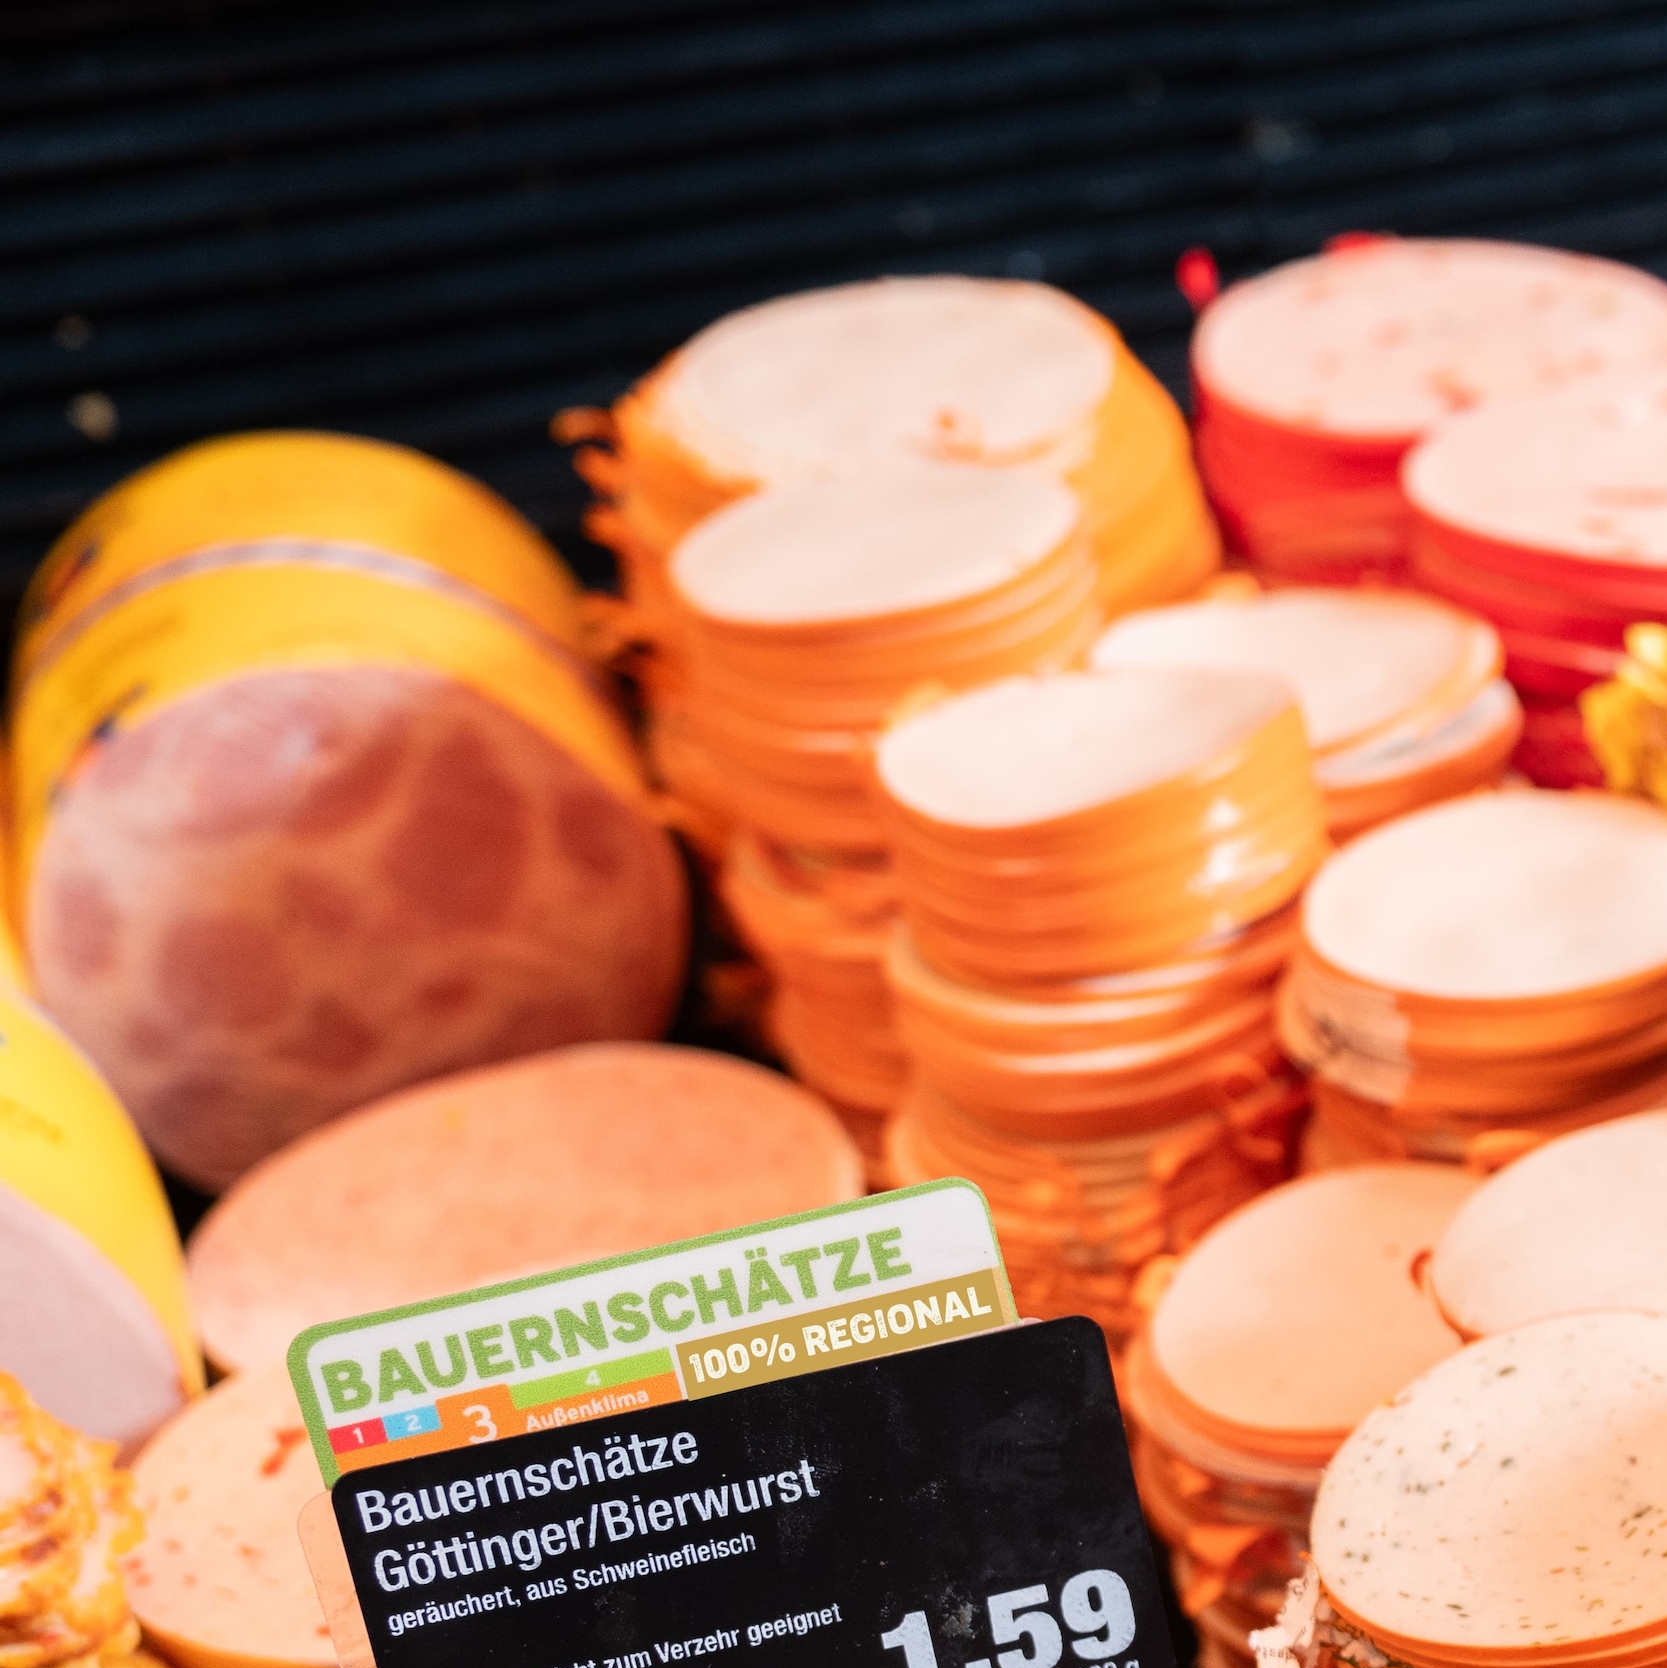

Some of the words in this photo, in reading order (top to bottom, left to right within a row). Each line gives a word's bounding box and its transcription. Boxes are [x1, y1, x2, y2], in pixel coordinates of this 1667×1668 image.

[320, 1227, 912, 1414] BAUERNSCHÄTZE
[688, 1334, 796, 1383] 100%
[802, 1287, 992, 1356] REGIONAL
[352, 1427, 365, 1444] 1
[404, 1414, 422, 1432] 2
[462, 1404, 498, 1444] 3
[525, 1389, 650, 1433] Außenklima
[585, 1369, 601, 1386] 4
[355, 1431, 699, 1534] Bauernschätze
[374, 1458, 820, 1592] Göttinger/Bierwurst
[388, 1586, 522, 1636] geräuchert,
[526, 1577, 568, 1602] aus
[574, 1532, 756, 1590] Schweinefleisch
[655, 1627, 741, 1665] Verzehr
[747, 1603, 843, 1647] geeignet
